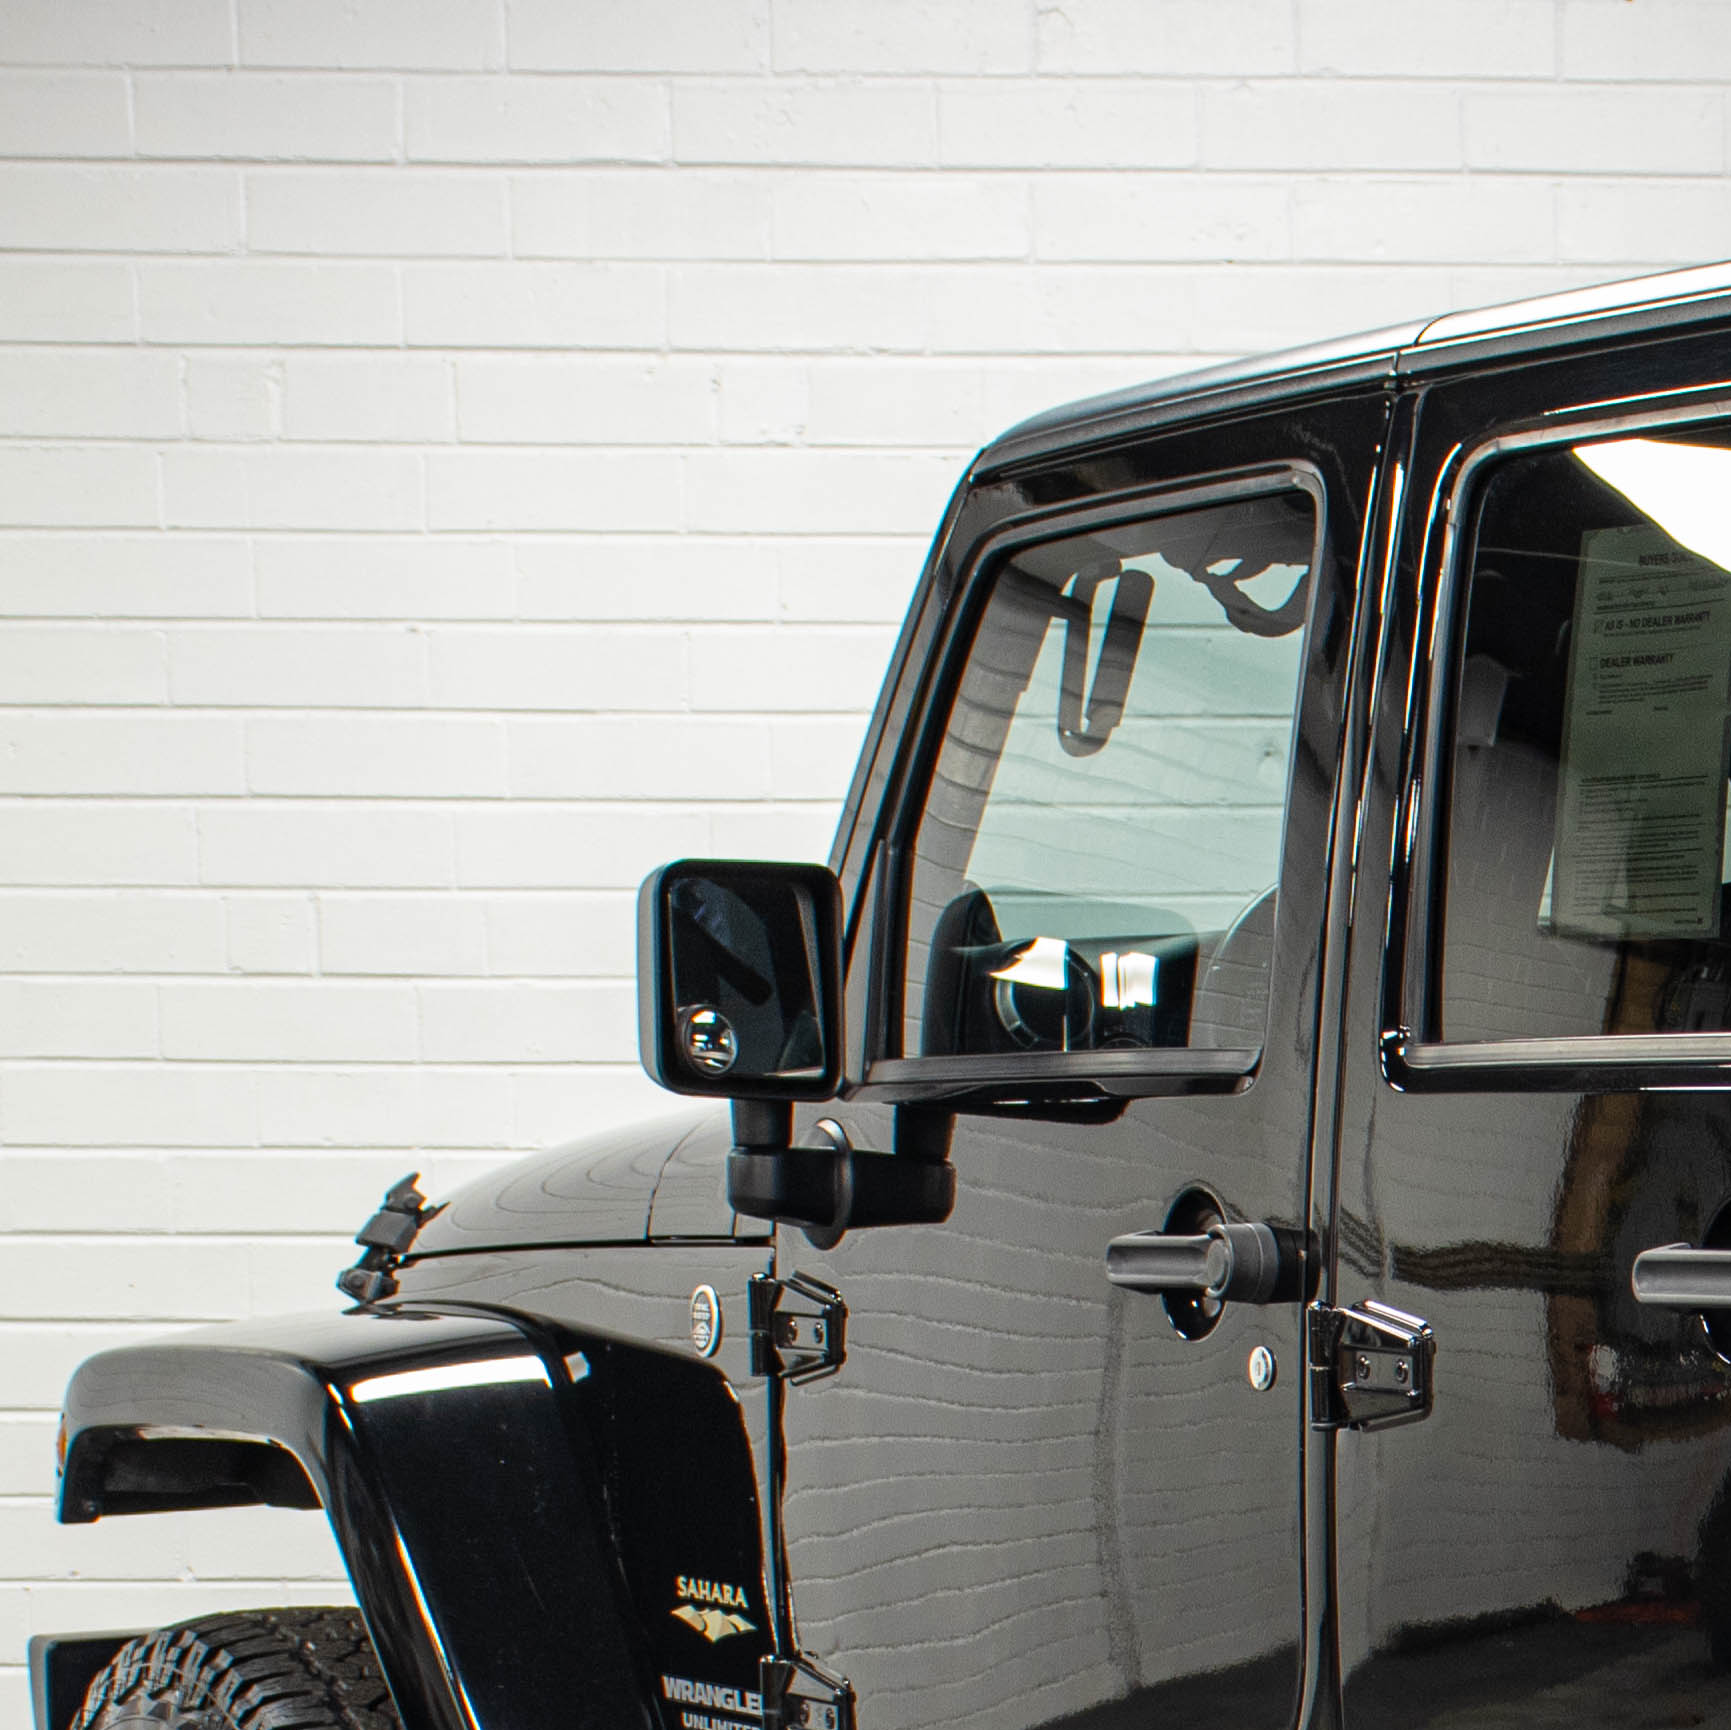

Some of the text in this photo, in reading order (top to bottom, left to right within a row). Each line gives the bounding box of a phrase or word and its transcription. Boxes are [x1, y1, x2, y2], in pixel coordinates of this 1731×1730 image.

[1641, 613, 1673, 628] DEALER
[1674, 609, 1711, 625] WARRANTY
[1600, 652, 1674, 669] DEALER WARRANTY
[675, 1575, 748, 1609] SAHARA
[661, 1675, 763, 1716] WRANGLE
